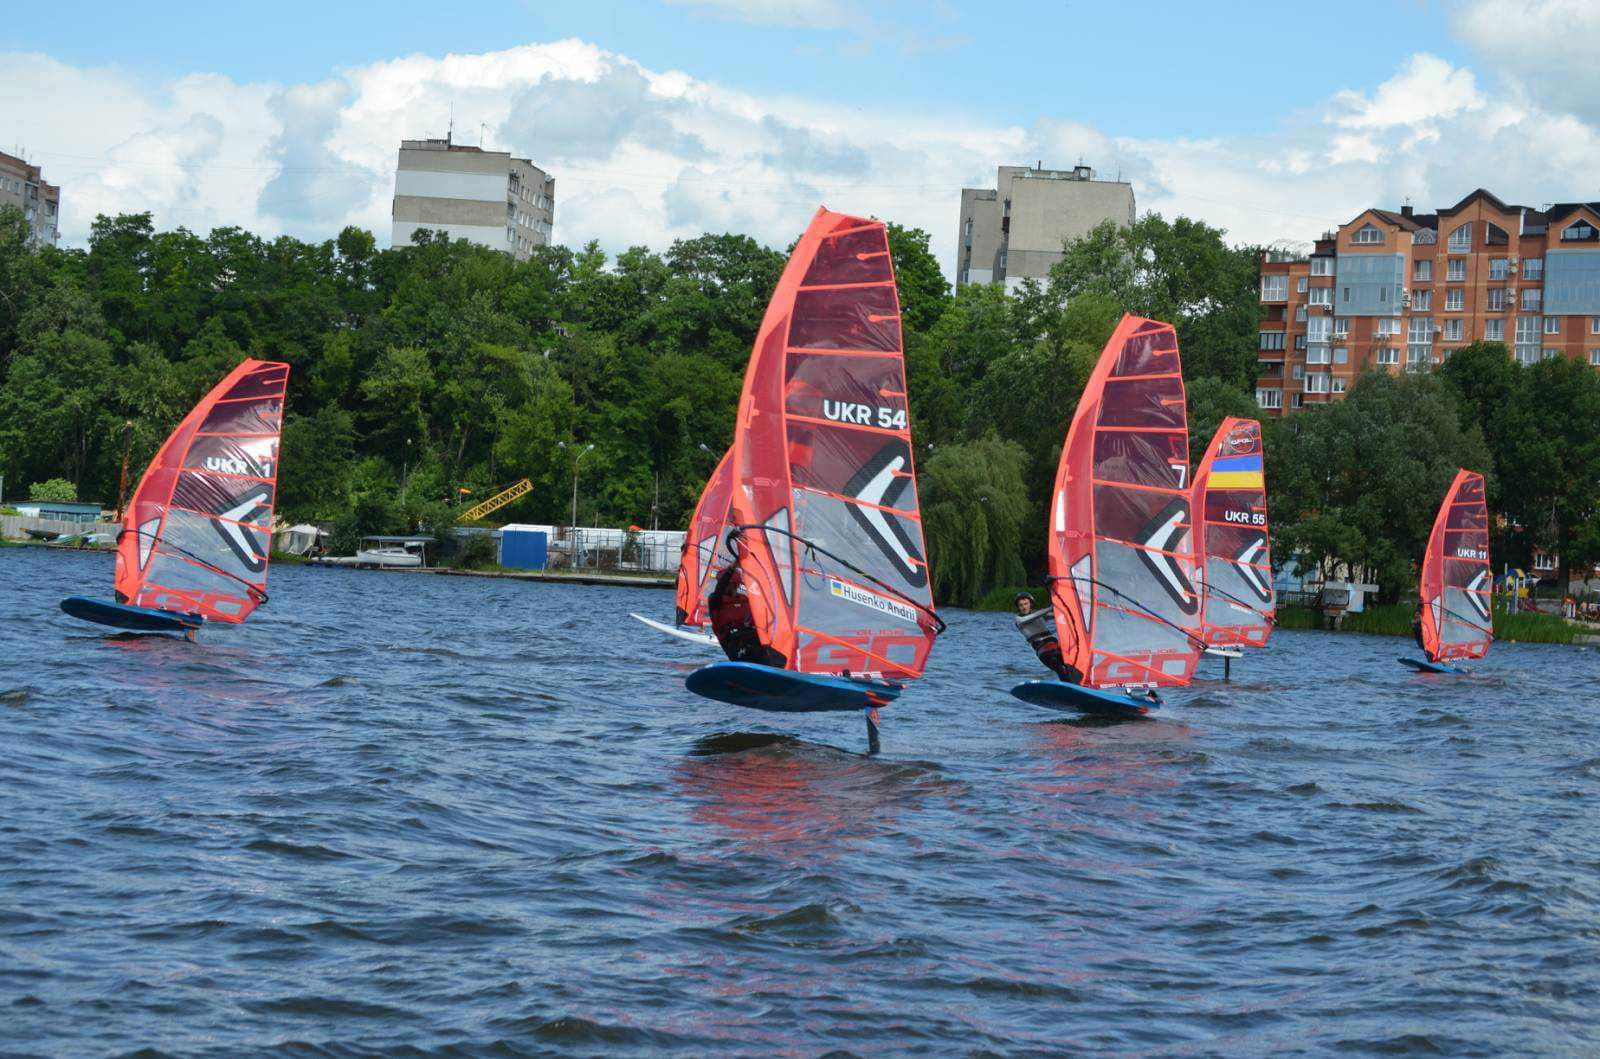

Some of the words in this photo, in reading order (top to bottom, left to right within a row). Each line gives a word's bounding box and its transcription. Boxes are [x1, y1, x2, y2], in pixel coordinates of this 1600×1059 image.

[824, 399, 871, 425] UKR
[878, 407, 906, 430] 54
[207, 457, 247, 475] UKR
[1171, 464, 1186, 489] 7
[1225, 510, 1249, 523] UKR
[1457, 547, 1476, 558] UKR
[1479, 550, 1487, 559] 11
[843, 584, 885, 610] Husenko
[887, 600, 916, 620] Andrii
